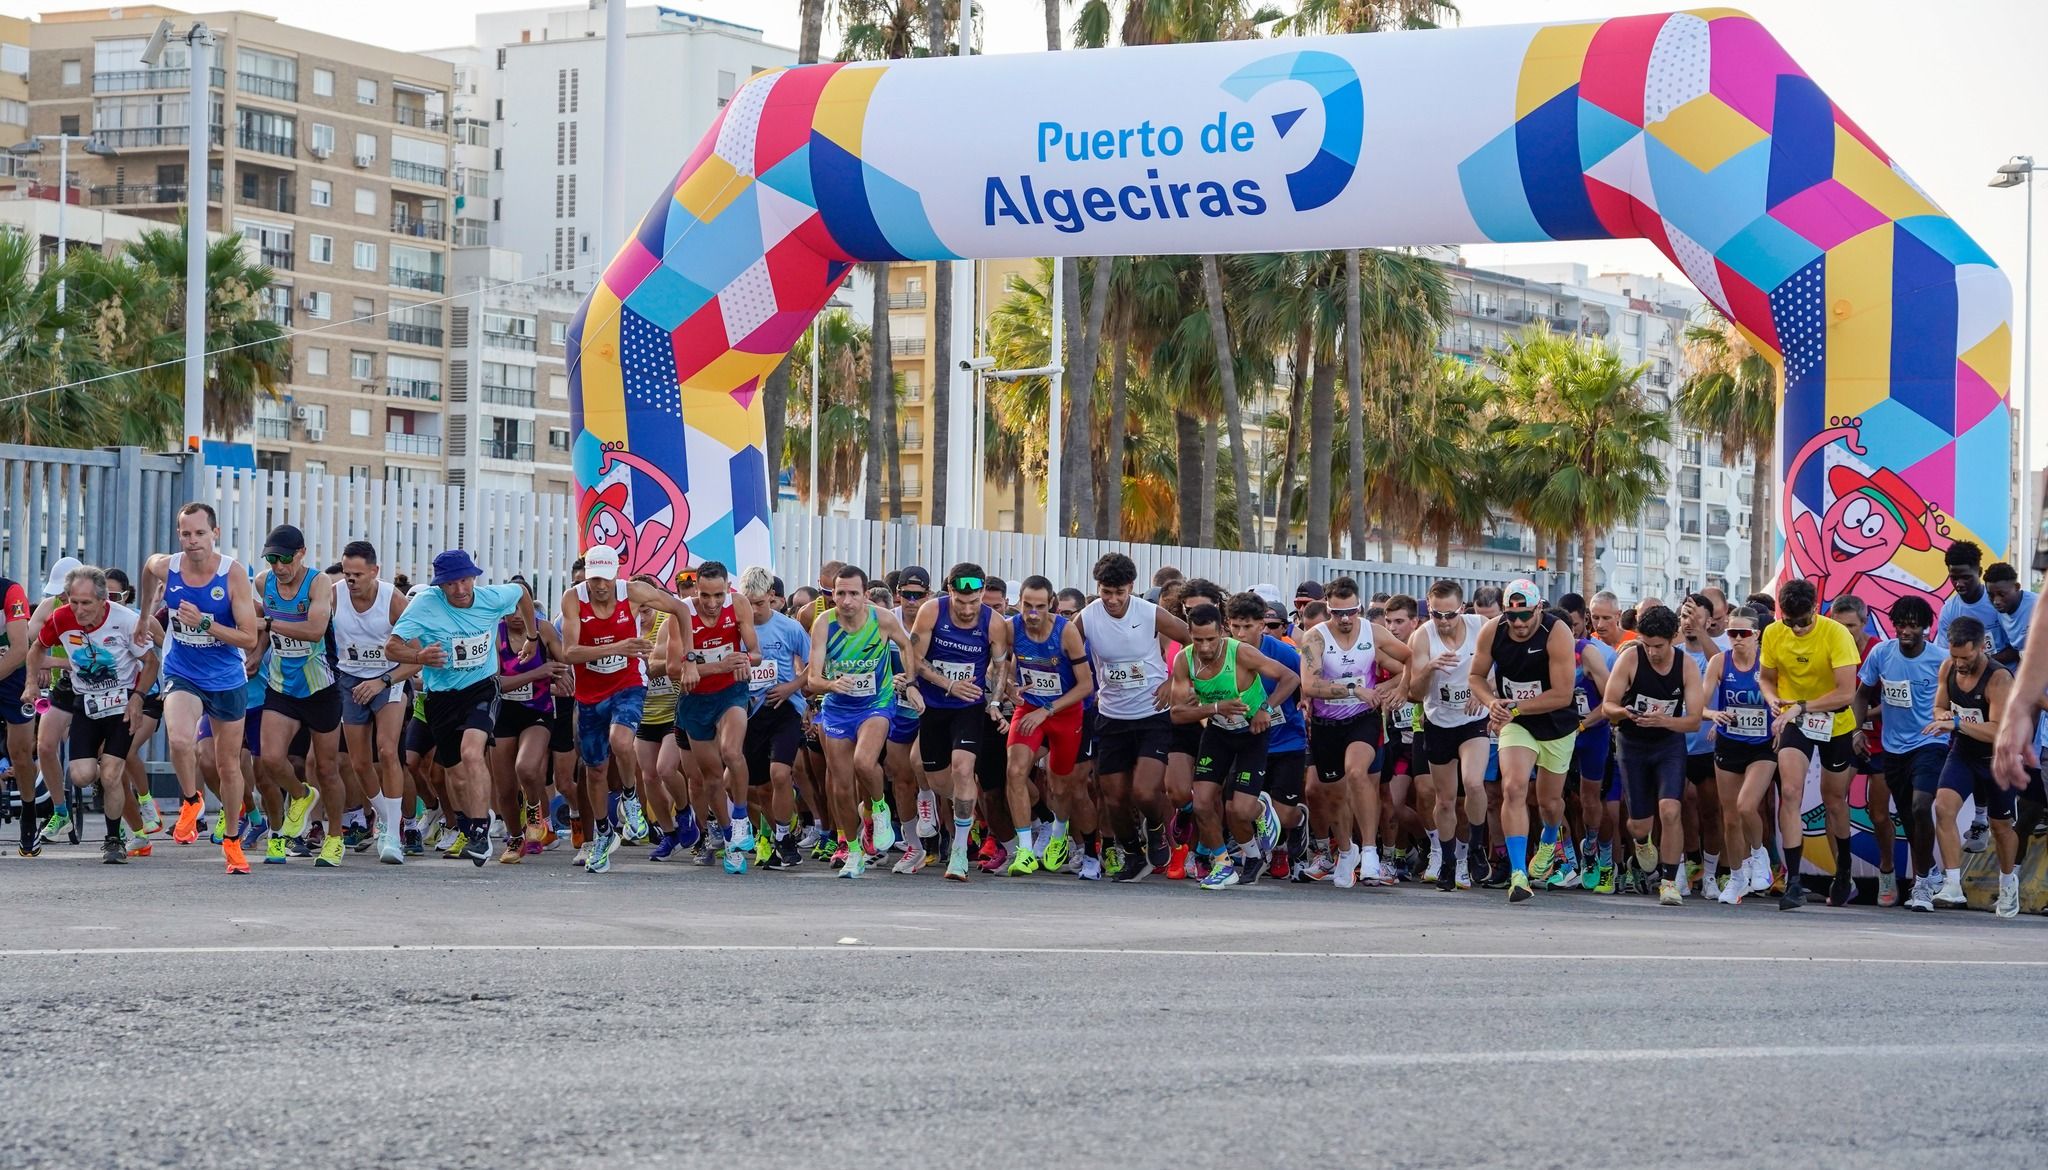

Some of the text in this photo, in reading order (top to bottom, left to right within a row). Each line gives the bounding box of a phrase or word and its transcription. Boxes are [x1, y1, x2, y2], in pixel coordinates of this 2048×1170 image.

[1038, 111, 1255, 163] Puerto de
[984, 168, 1268, 234] Algeciras
[285, 637, 303, 649] 911
[472, 641, 488, 656] 865
[935, 637, 982, 653] TROTASIERRA
[362, 649, 381, 659] 459
[752, 669, 775, 680] 1209
[946, 671, 970, 681] 1186
[1109, 670, 1127, 680] 229
[651, 677, 667, 688] 382
[856, 679, 869, 689] 92
[1036, 678, 1055, 688] 530
[1454, 688, 1472, 701] 808
[1517, 689, 1536, 700] 223
[1726, 690, 1763, 705] RCM
[1886, 688, 1908, 698] 1276
[101, 696, 121, 708] 774
[1740, 716, 1764, 727] 1129
[1808, 718, 1826, 730] 677
